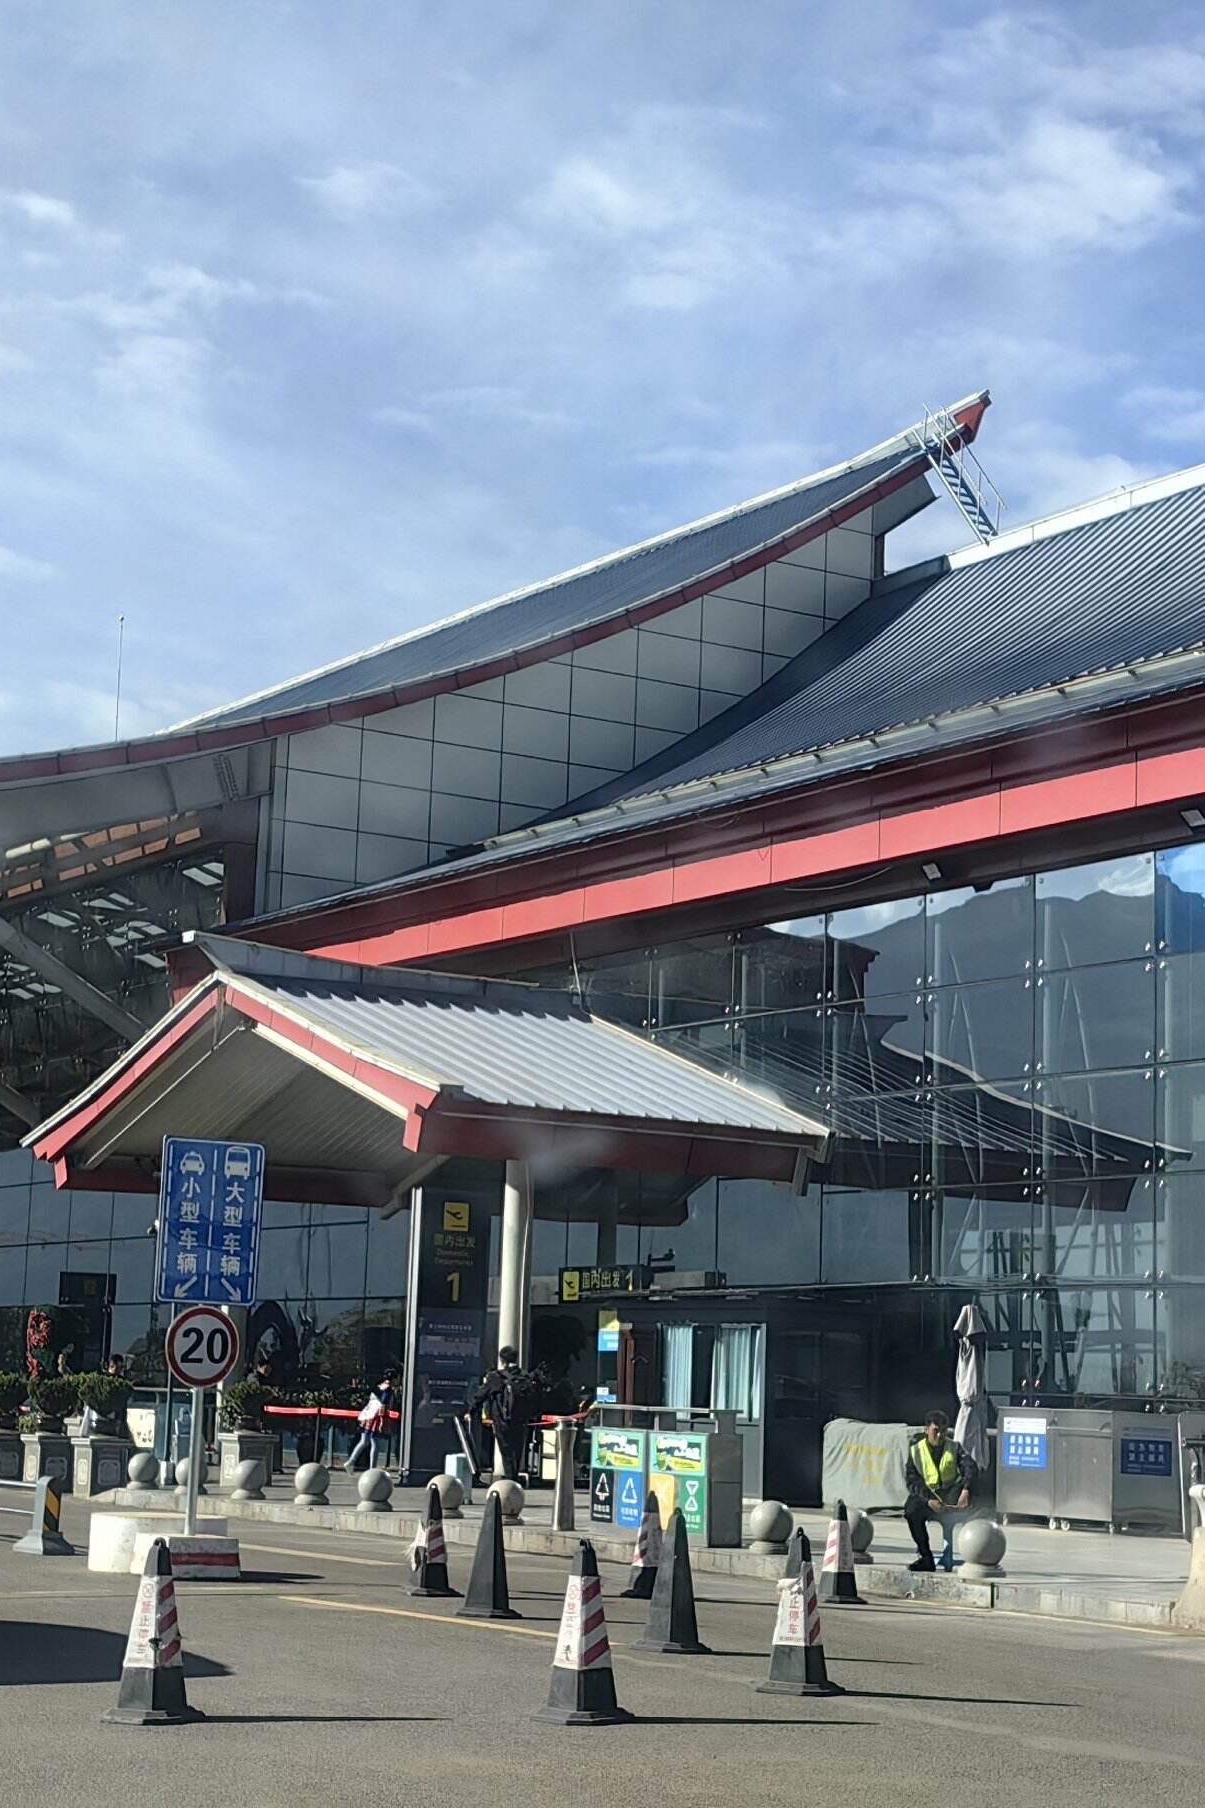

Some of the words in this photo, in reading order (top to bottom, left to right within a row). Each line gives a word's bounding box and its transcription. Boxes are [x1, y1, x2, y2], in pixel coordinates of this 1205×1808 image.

[177, 1176, 200, 1275] 小型车辆
[220, 1181, 244, 1277] 大型车辆
[446, 1272, 460, 1302] 1
[582, 1269, 621, 1289] 国内出发
[180, 1327, 229, 1365] 20
